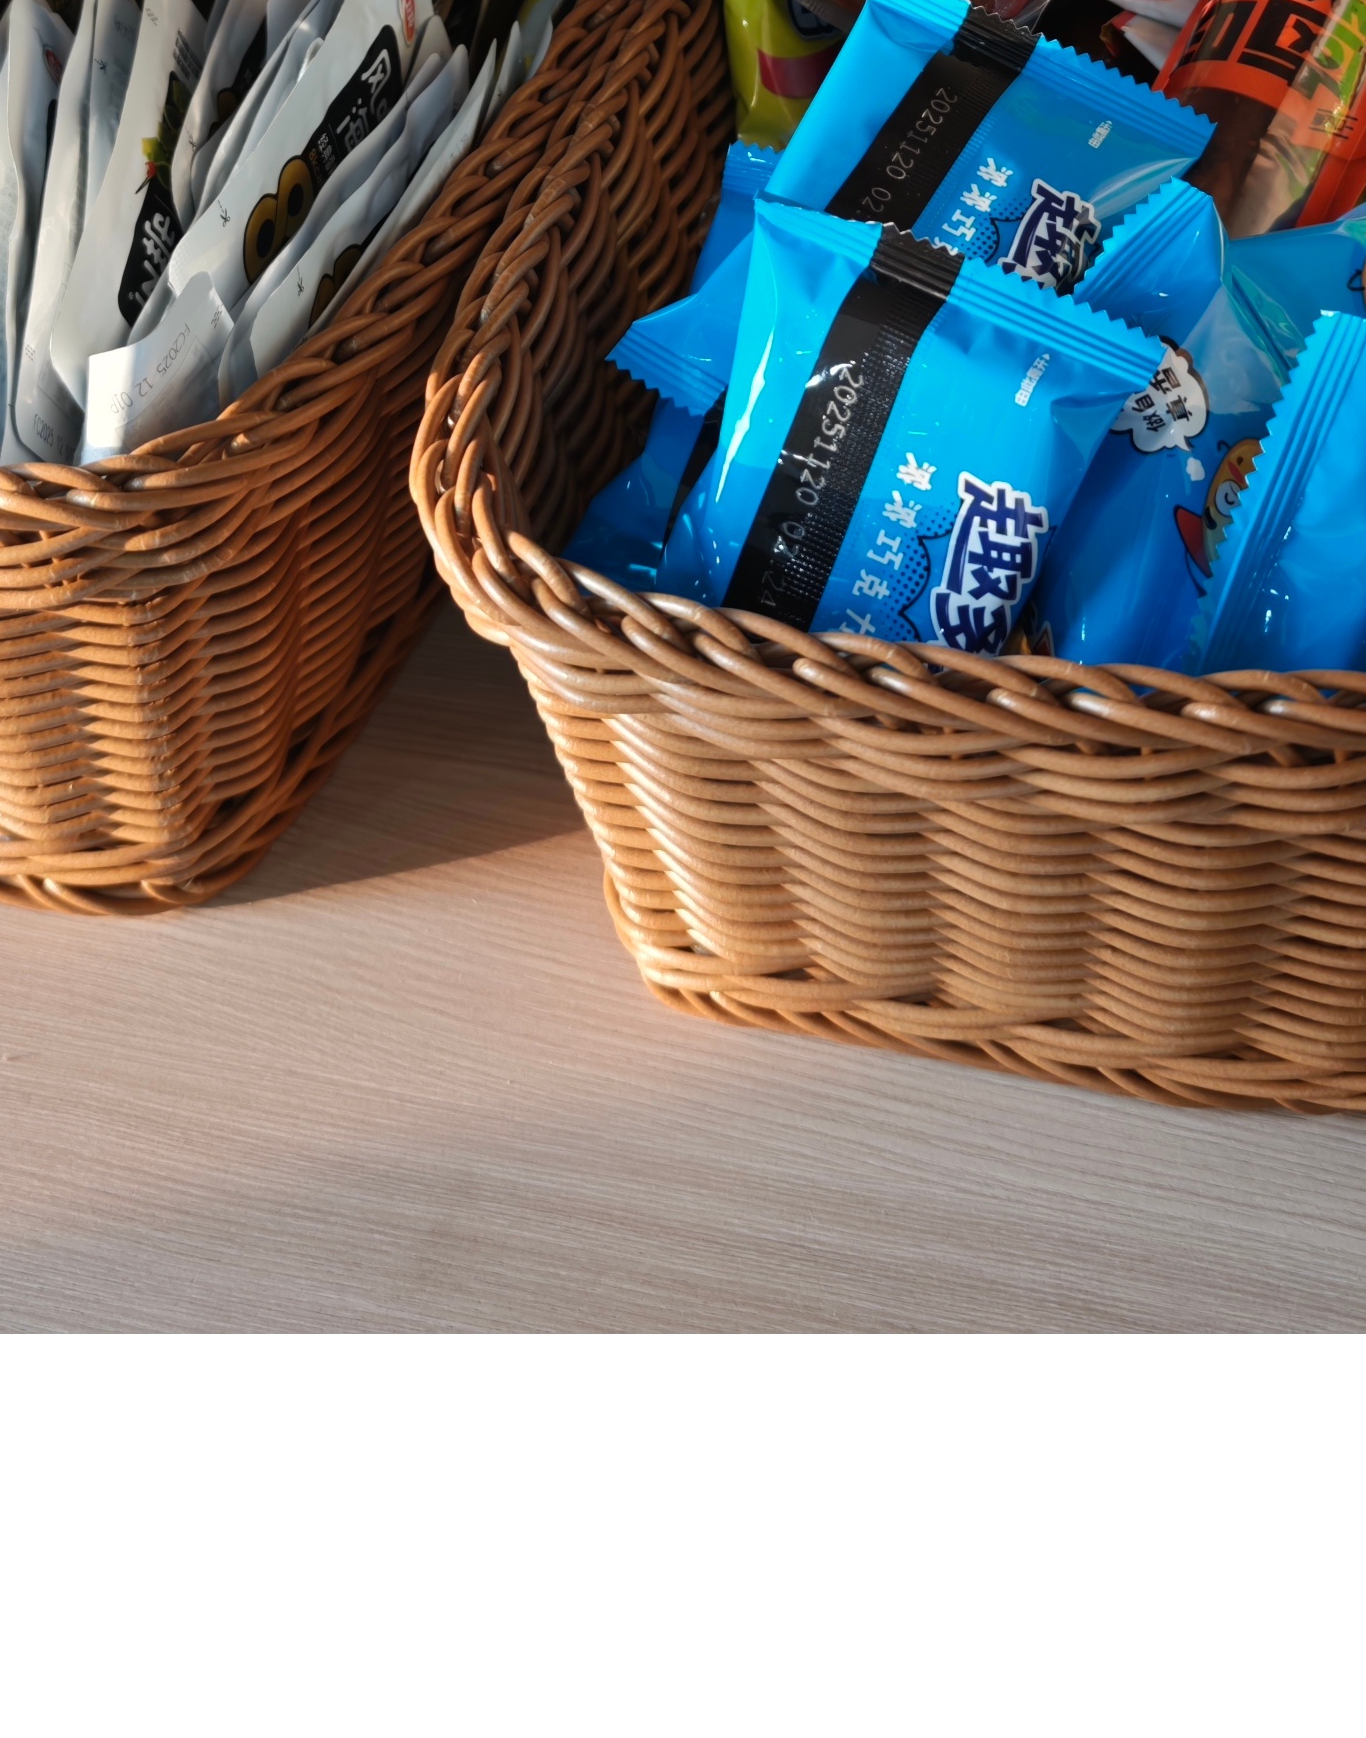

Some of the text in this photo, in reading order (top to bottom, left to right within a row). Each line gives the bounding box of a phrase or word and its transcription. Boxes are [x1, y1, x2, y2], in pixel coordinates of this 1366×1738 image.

[883, 84, 963, 185] 20251120
[133, 377, 155, 398] 12
[154, 322, 191, 376] FC2025
[794, 361, 868, 509] 20251120
